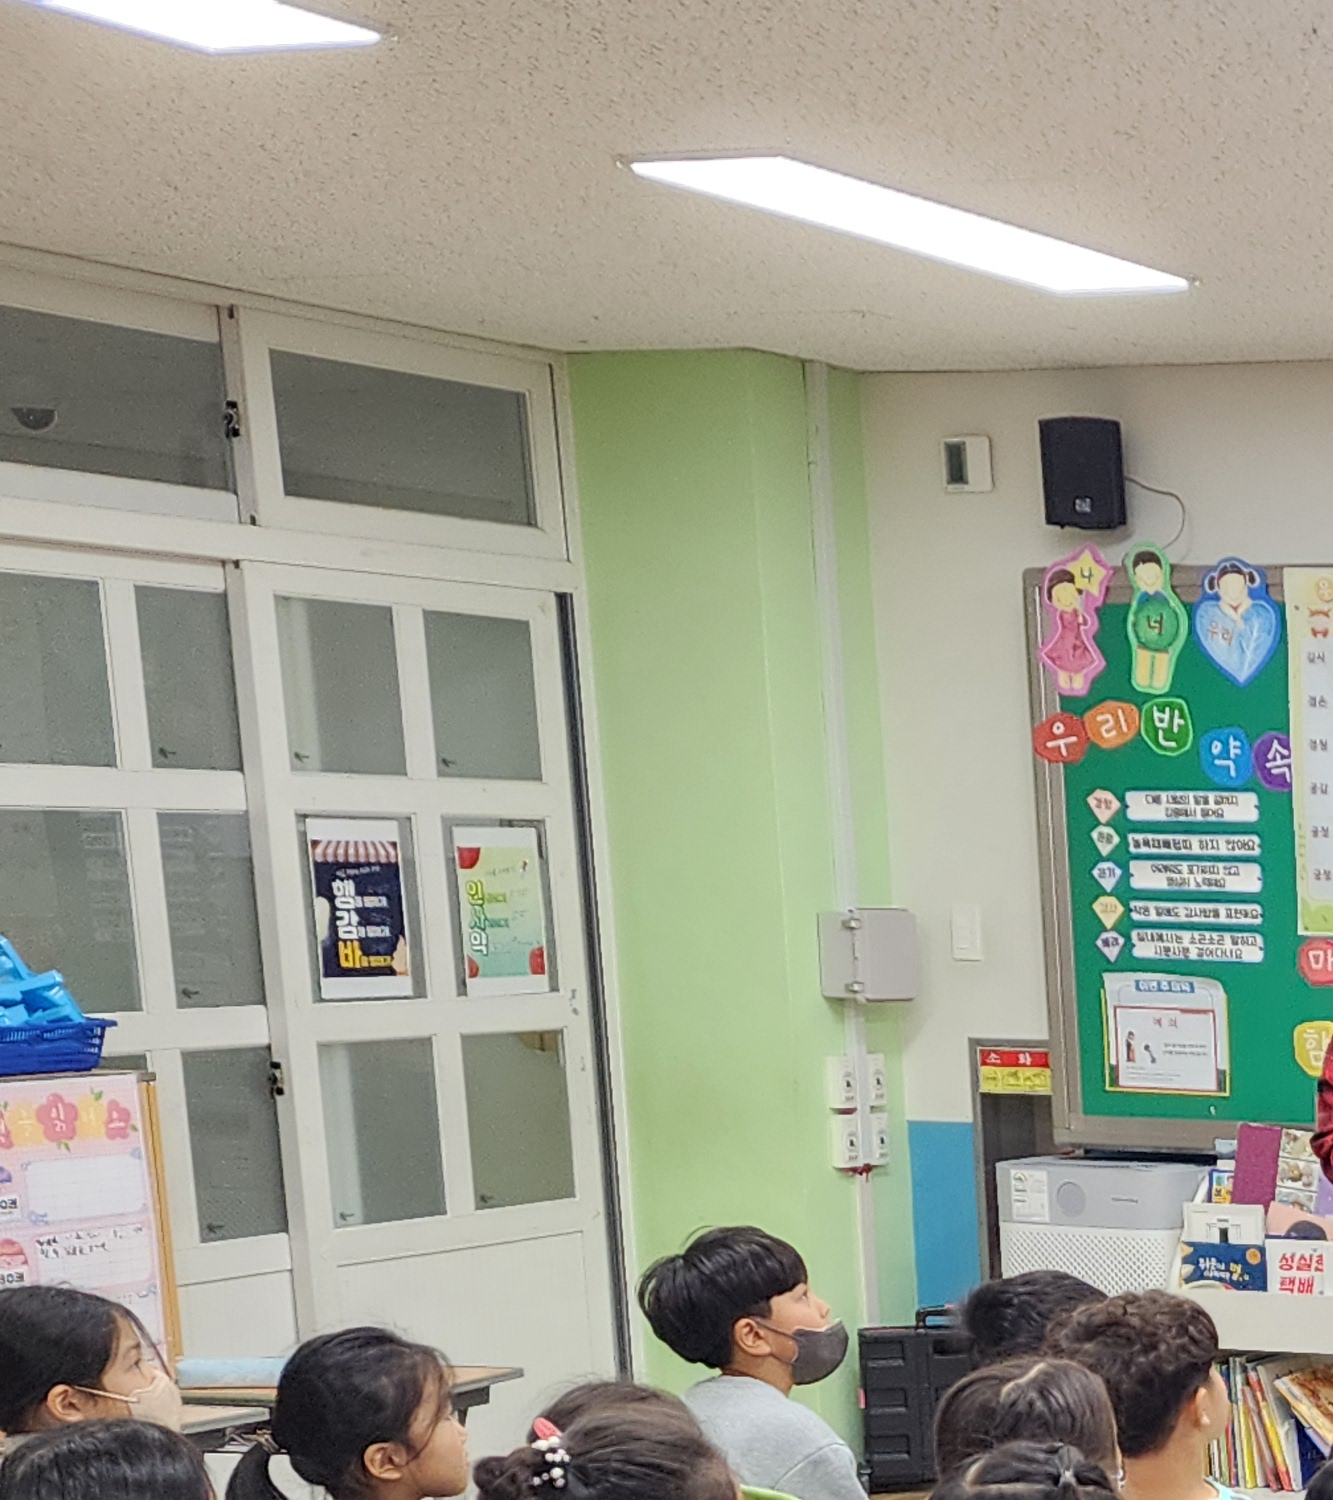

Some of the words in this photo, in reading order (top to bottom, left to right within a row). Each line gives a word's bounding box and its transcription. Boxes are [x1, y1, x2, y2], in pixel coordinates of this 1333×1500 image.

[1148, 613, 1163, 636] 너
[1207, 621, 1234, 646] 우리
[1211, 735, 1291, 783] 약속
[1199, 839, 1220, 851] 하지
[1279, 1276, 1316, 1296] 택배
